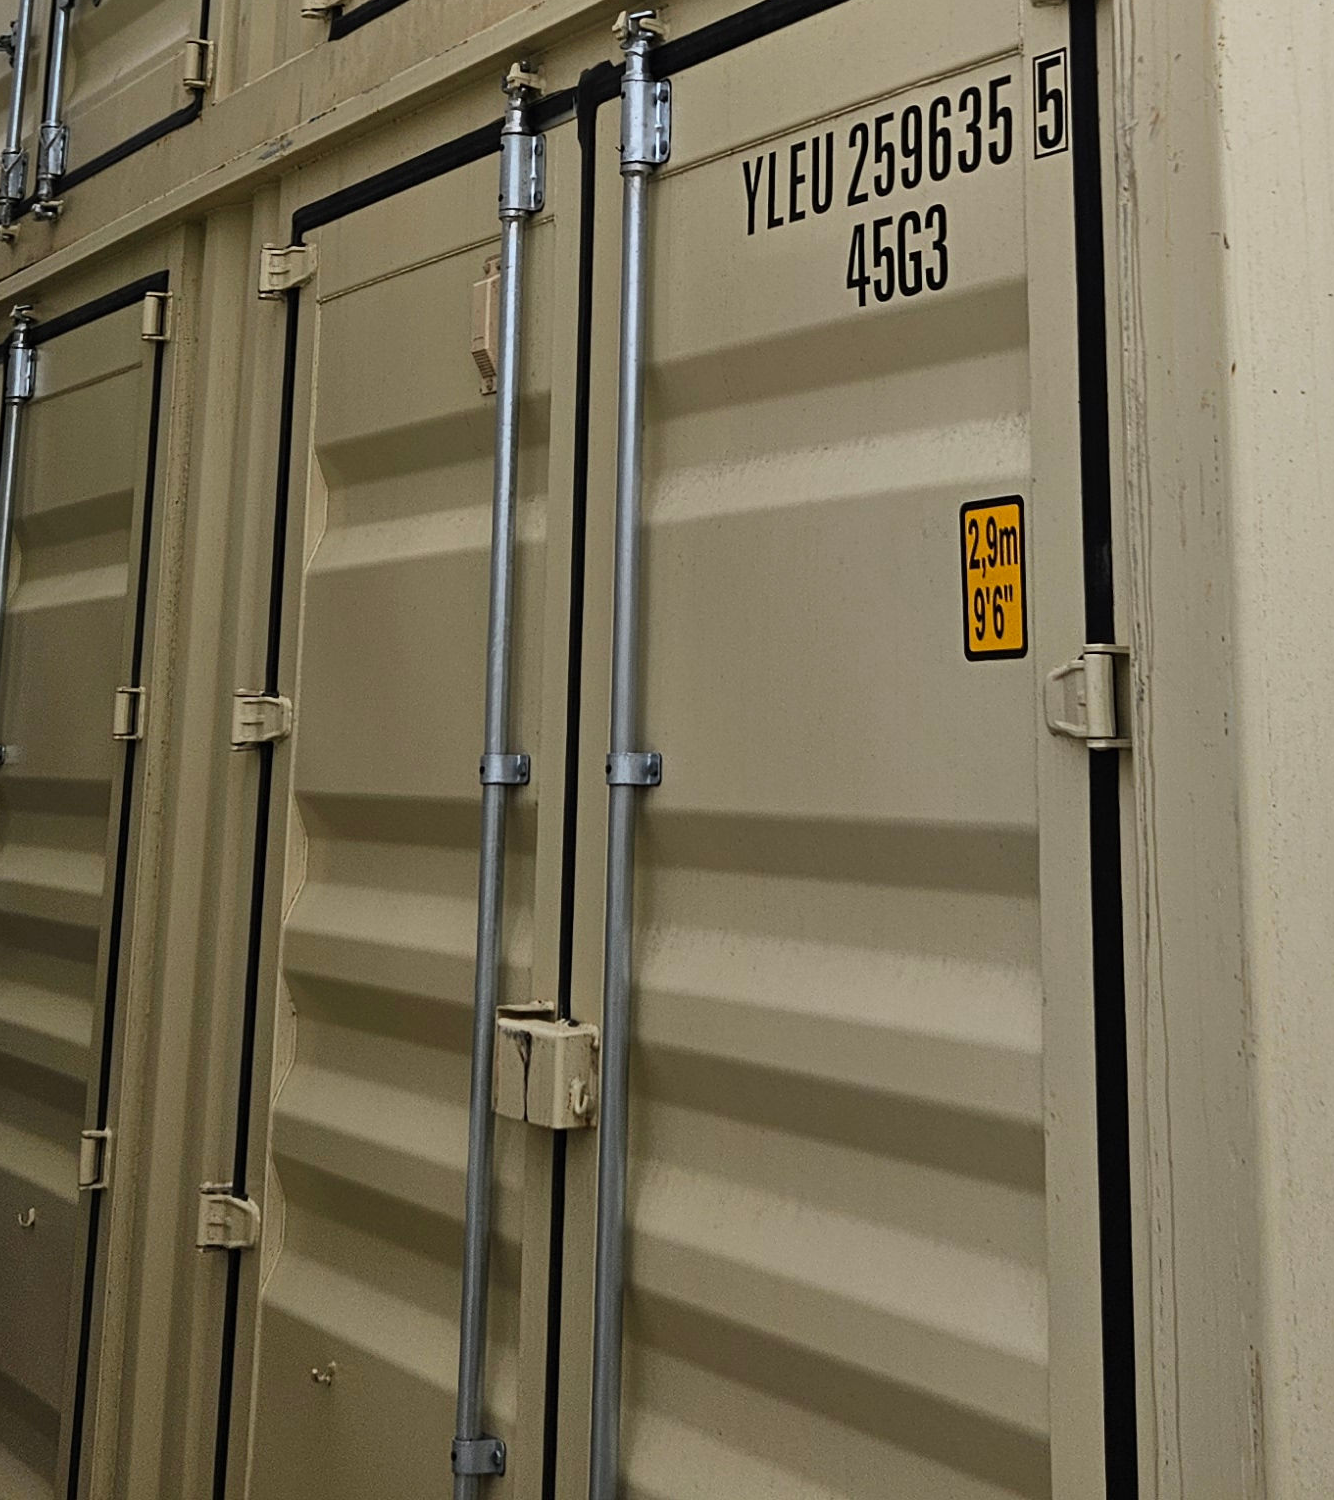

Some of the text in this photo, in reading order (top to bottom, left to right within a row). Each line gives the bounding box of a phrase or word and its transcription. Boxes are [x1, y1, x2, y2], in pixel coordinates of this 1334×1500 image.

[742, 54, 1065, 236] YLEU 259635 5
[846, 203, 949, 307] 45G3
[968, 515, 1018, 579] 2,9m
[973, 583, 1014, 641] 9'6"
